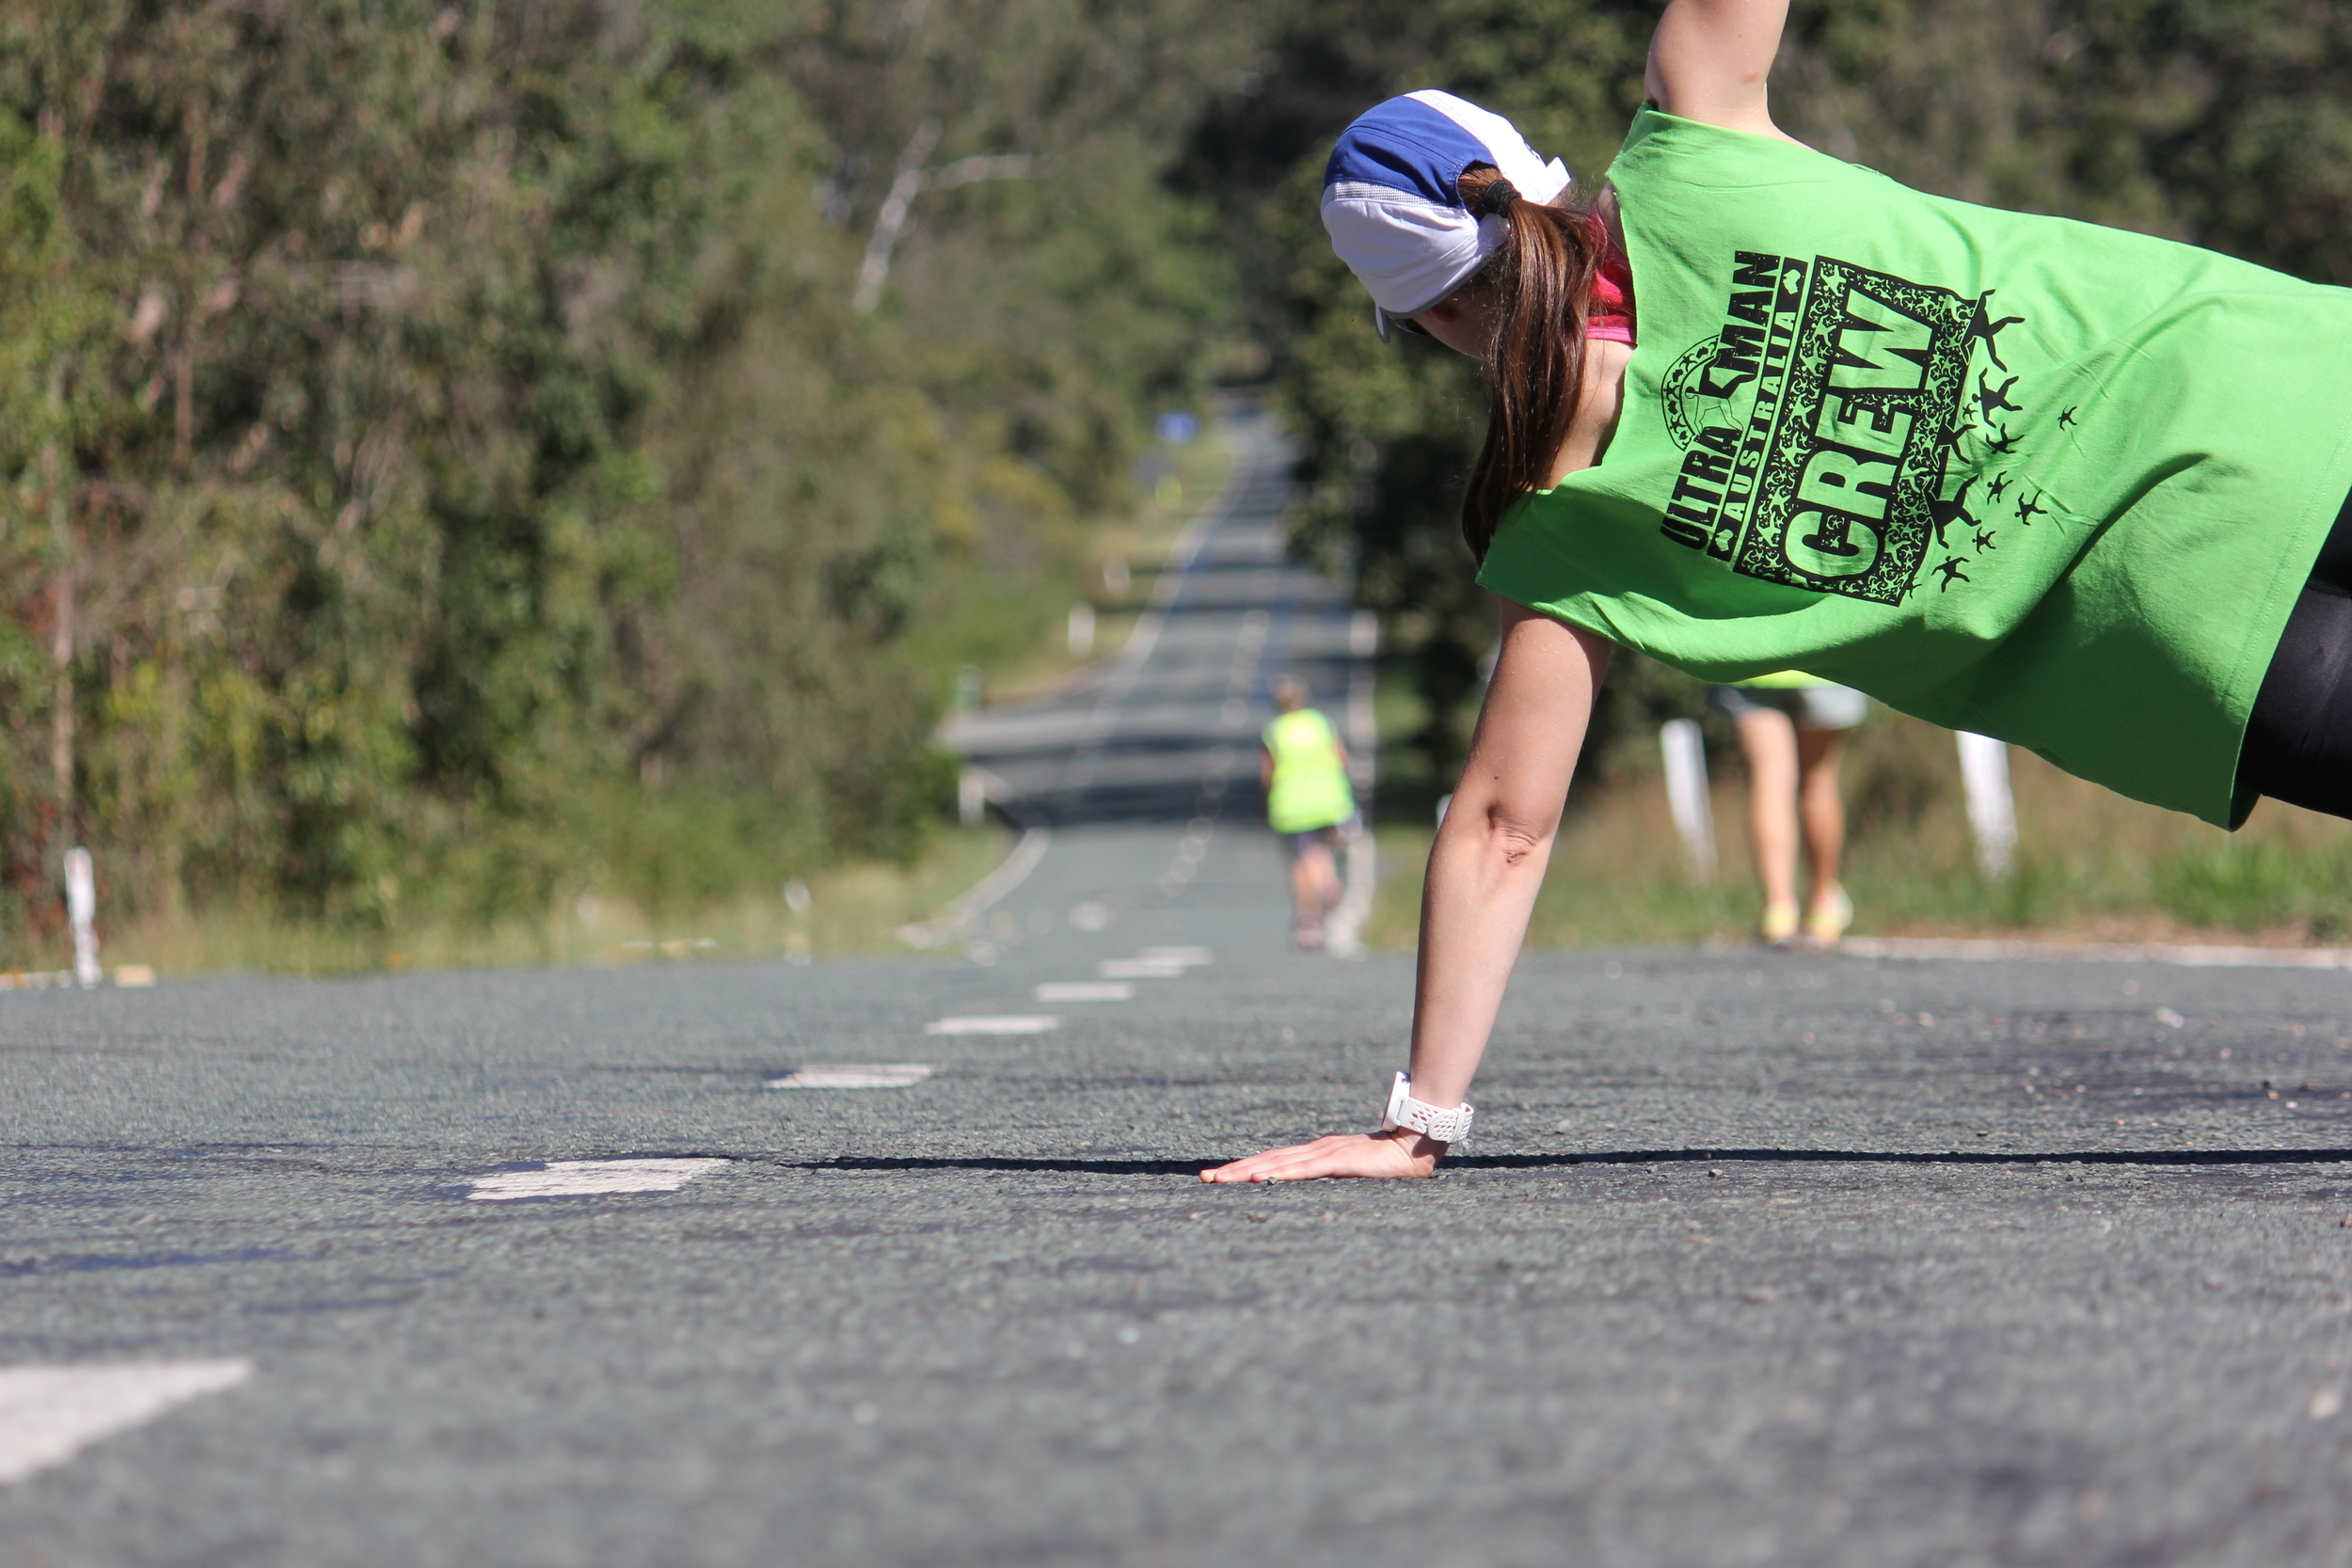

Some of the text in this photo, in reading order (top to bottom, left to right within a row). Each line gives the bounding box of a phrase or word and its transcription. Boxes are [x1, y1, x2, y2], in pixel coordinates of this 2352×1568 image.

[1660, 250, 1781, 551] ULTRA MAN
[1723, 311, 1798, 523] AUSTRALIA
[1785, 288, 1933, 578] CREW
